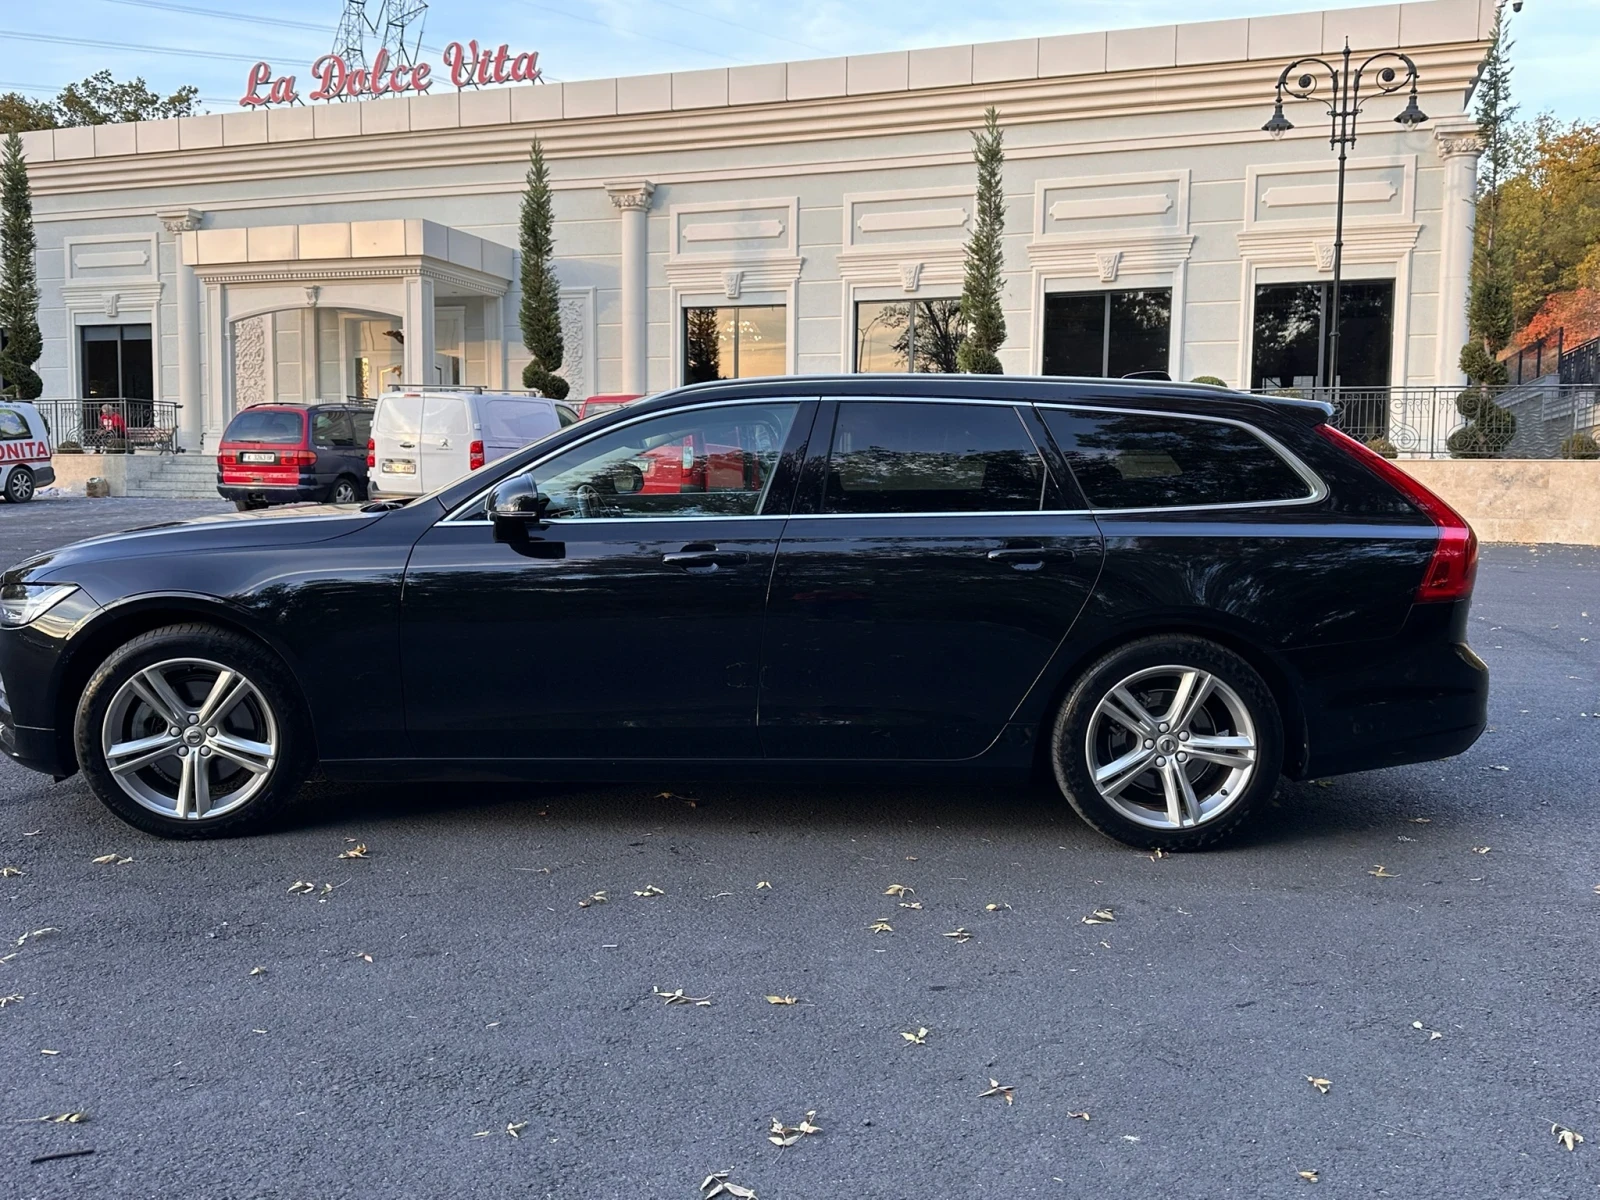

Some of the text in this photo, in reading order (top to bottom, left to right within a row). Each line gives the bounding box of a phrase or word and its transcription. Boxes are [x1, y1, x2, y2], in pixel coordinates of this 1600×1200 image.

[239, 39, 541, 107] La Dolce Vita
